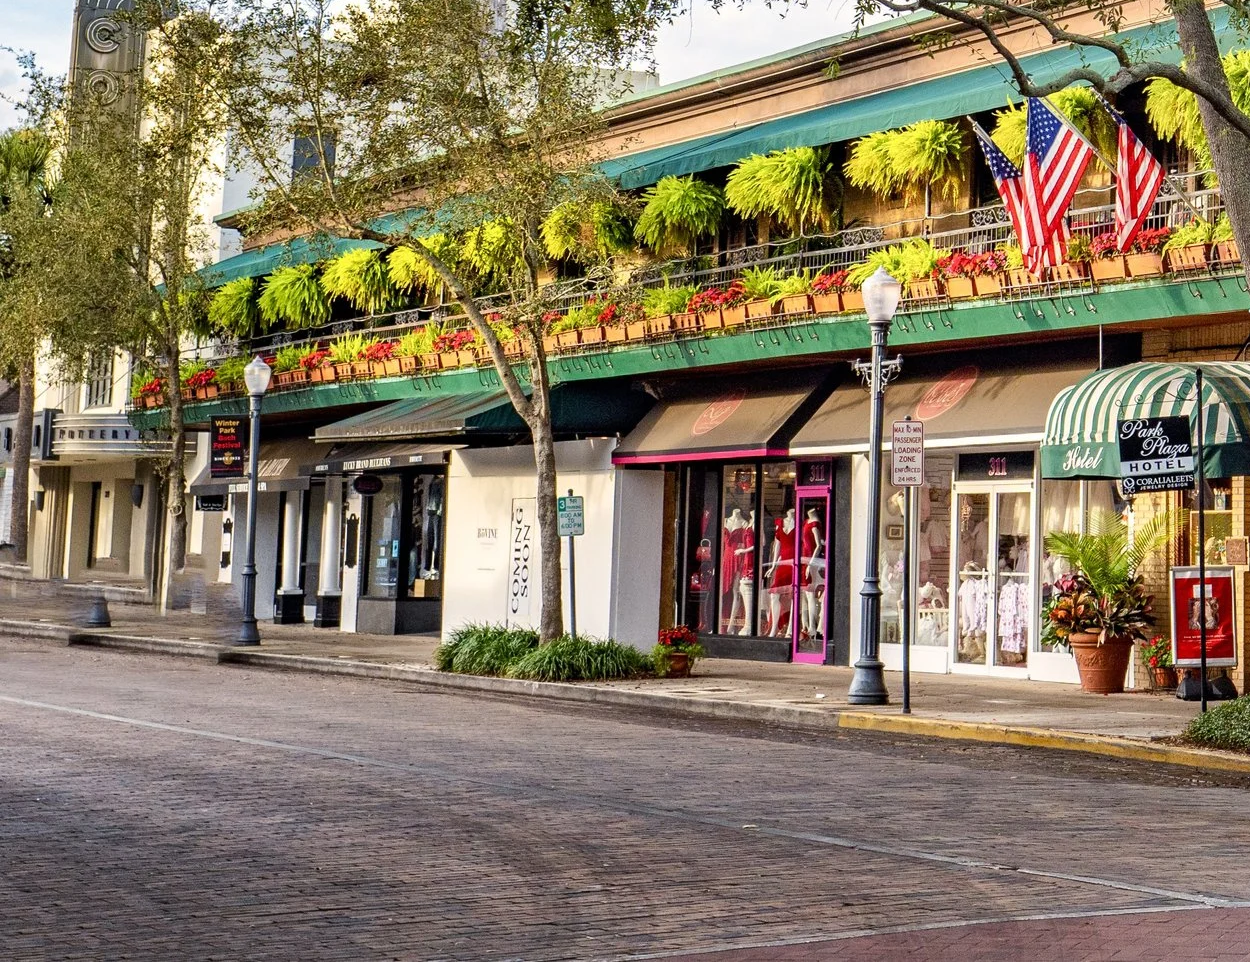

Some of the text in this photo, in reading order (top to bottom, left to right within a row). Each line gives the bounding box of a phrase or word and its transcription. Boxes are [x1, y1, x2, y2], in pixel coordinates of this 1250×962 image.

[214, 419, 240, 427] Winter
[1119, 418, 1164, 440] Park
[58, 429, 131, 440] POTTERY
[212, 441, 241, 449] Festival
[1140, 435, 1190, 460] Plaza
[898, 455, 916, 463] ZONE
[988, 456, 1007, 477] 311
[1062, 445, 1104, 471] Hotel
[1129, 458, 1186, 473] HOTEL
[809, 464, 825, 483] 311
[1139, 483, 1166, 491] JEWELRY
[559, 500, 565, 509] 3
[511, 508, 524, 614] COMING
[520, 524, 531, 598] SOON
